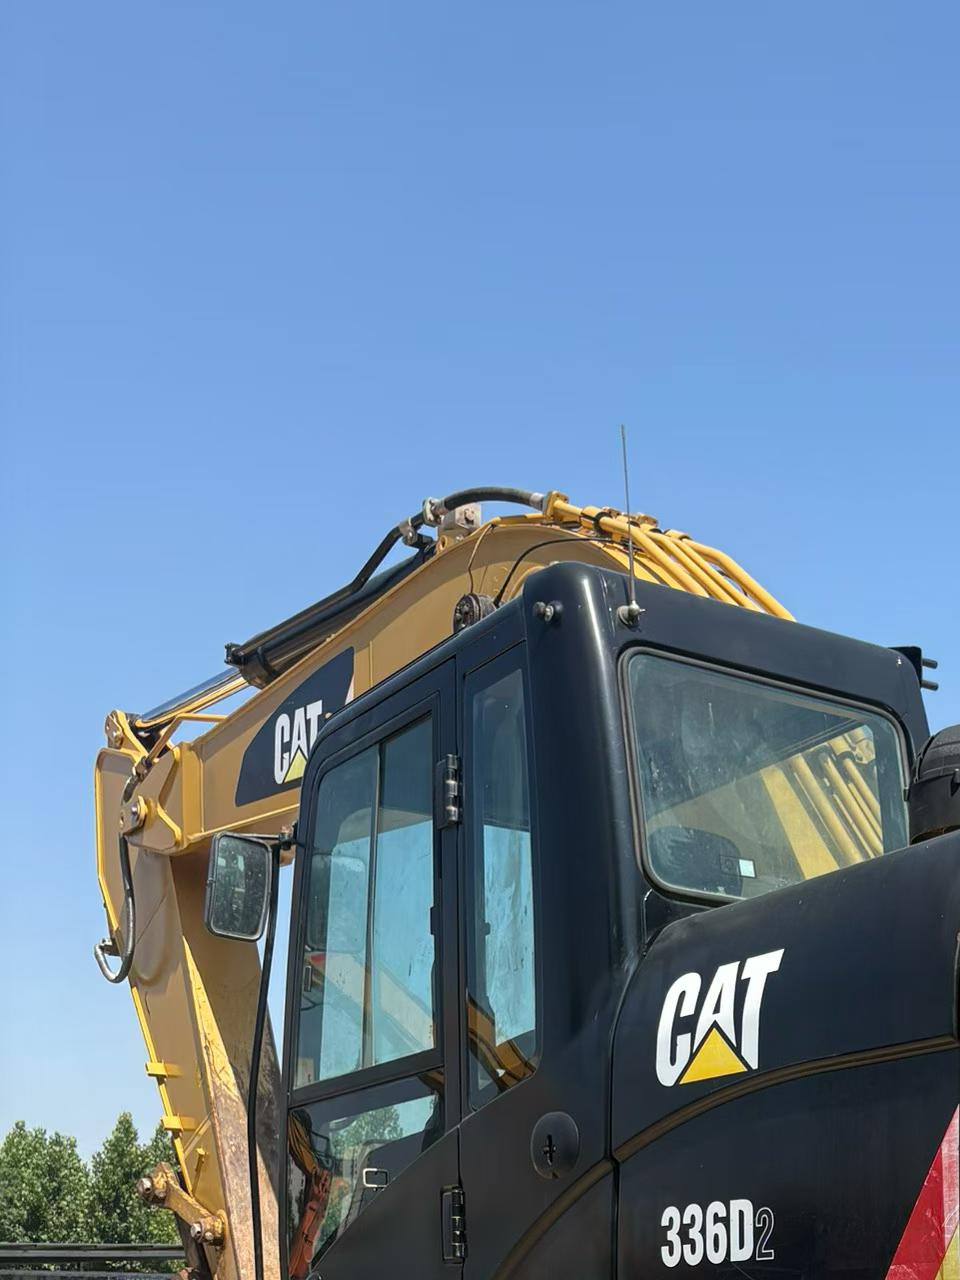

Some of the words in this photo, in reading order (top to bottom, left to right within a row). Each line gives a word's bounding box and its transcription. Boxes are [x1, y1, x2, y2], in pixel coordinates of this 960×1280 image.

[274, 700, 322, 784] CAT
[656, 949, 784, 1087] CAT
[660, 1199, 775, 1268] 336D2
